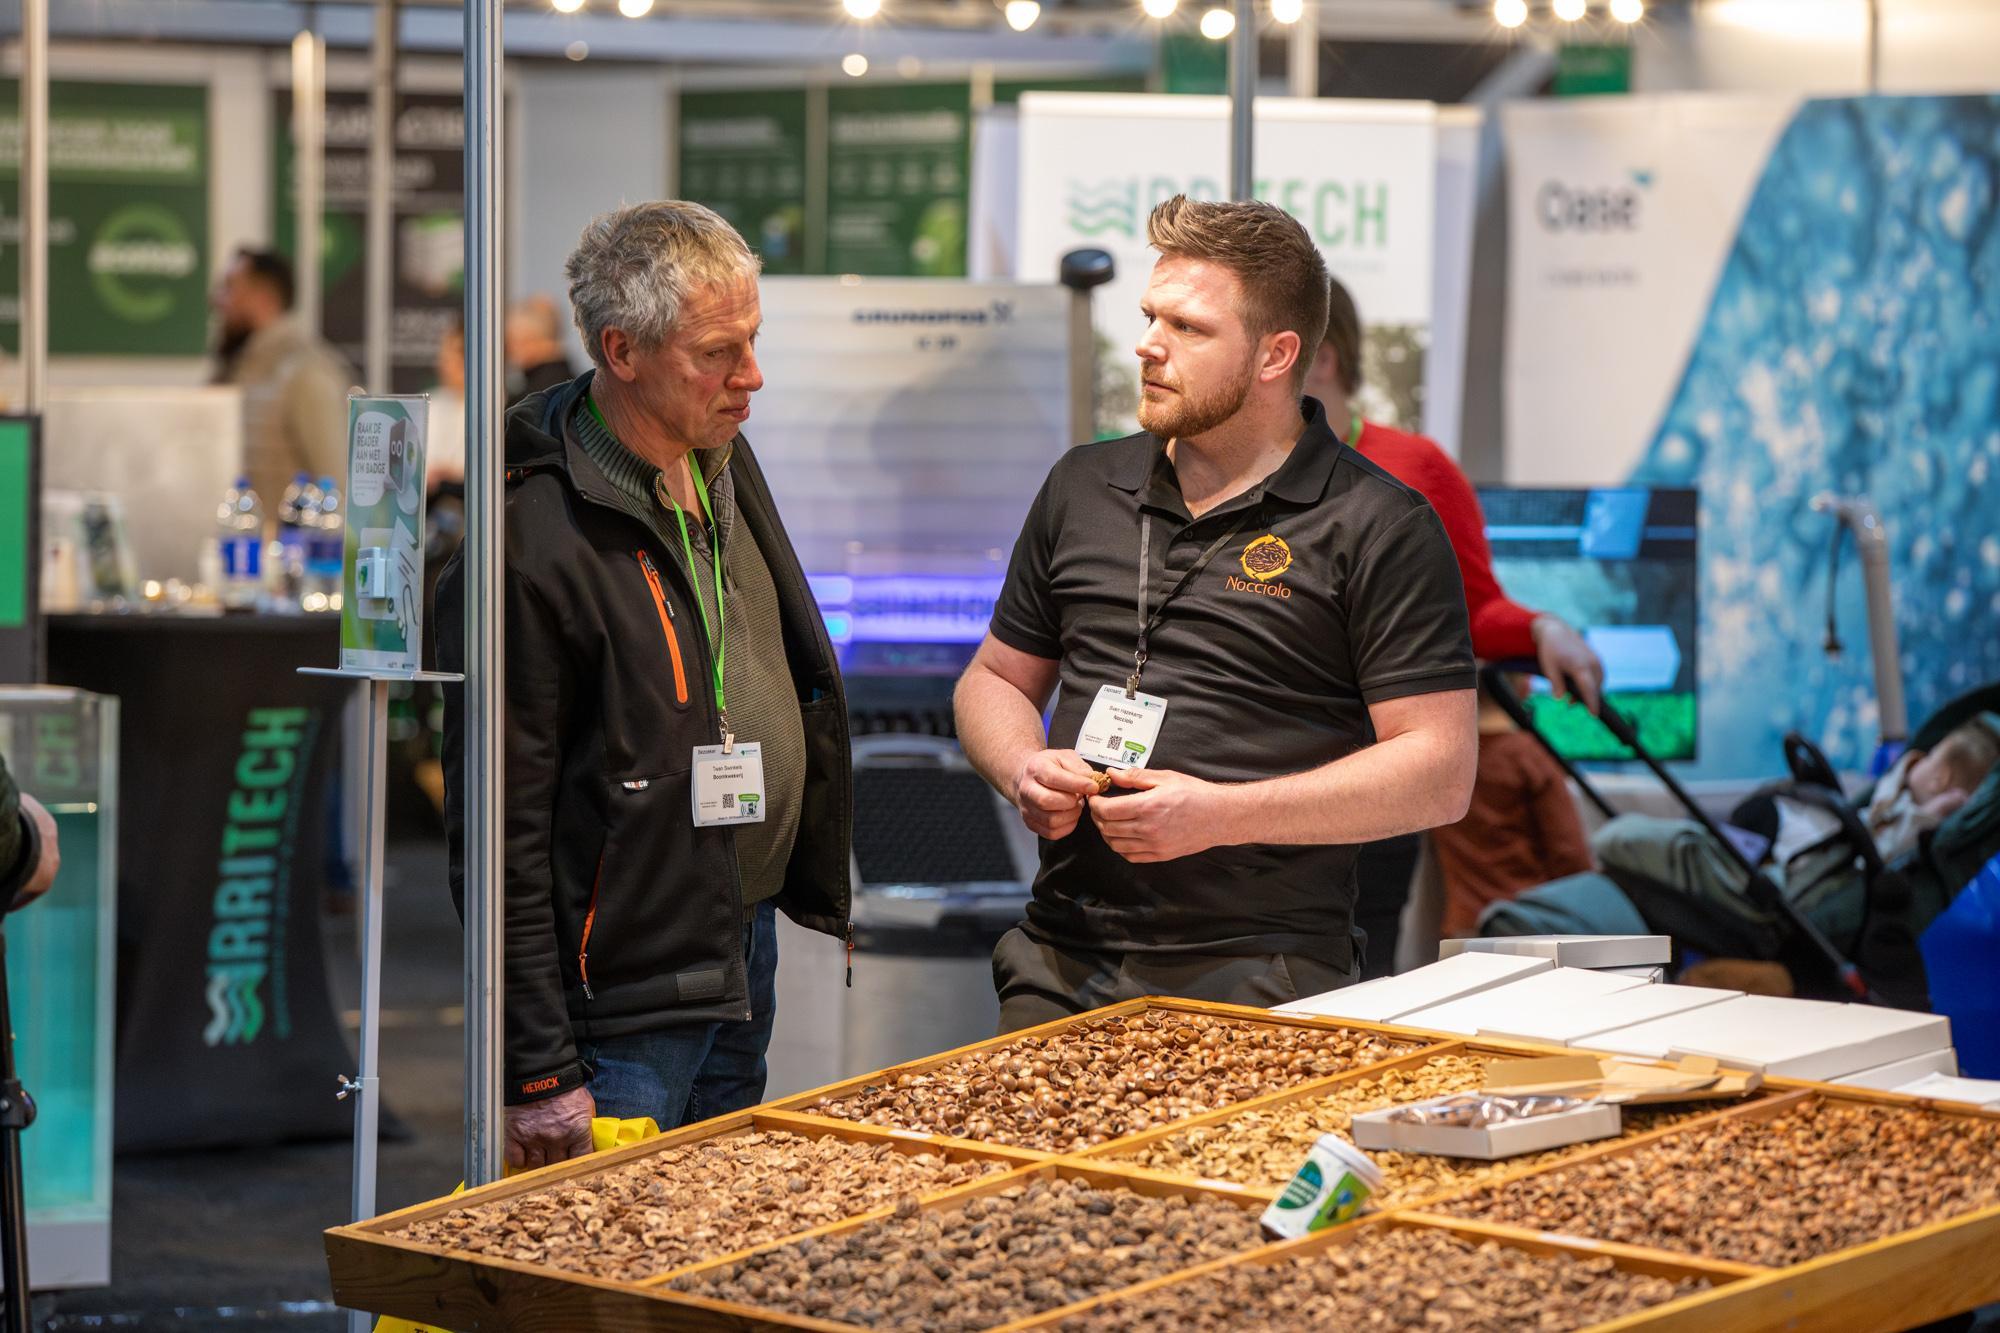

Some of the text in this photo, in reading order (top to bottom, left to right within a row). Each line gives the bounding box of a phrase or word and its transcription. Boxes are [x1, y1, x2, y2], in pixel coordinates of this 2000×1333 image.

[357, 422, 382, 434] RAAK DE
[357, 436, 380, 447] READER
[356, 449, 381, 460] AAN MET
[355, 463, 386, 474] UW BADGE
[1225, 575, 1292, 598] Nocciolo
[206, 706, 309, 979] IRRITECH
[522, 1076, 560, 1095] HEROCK
